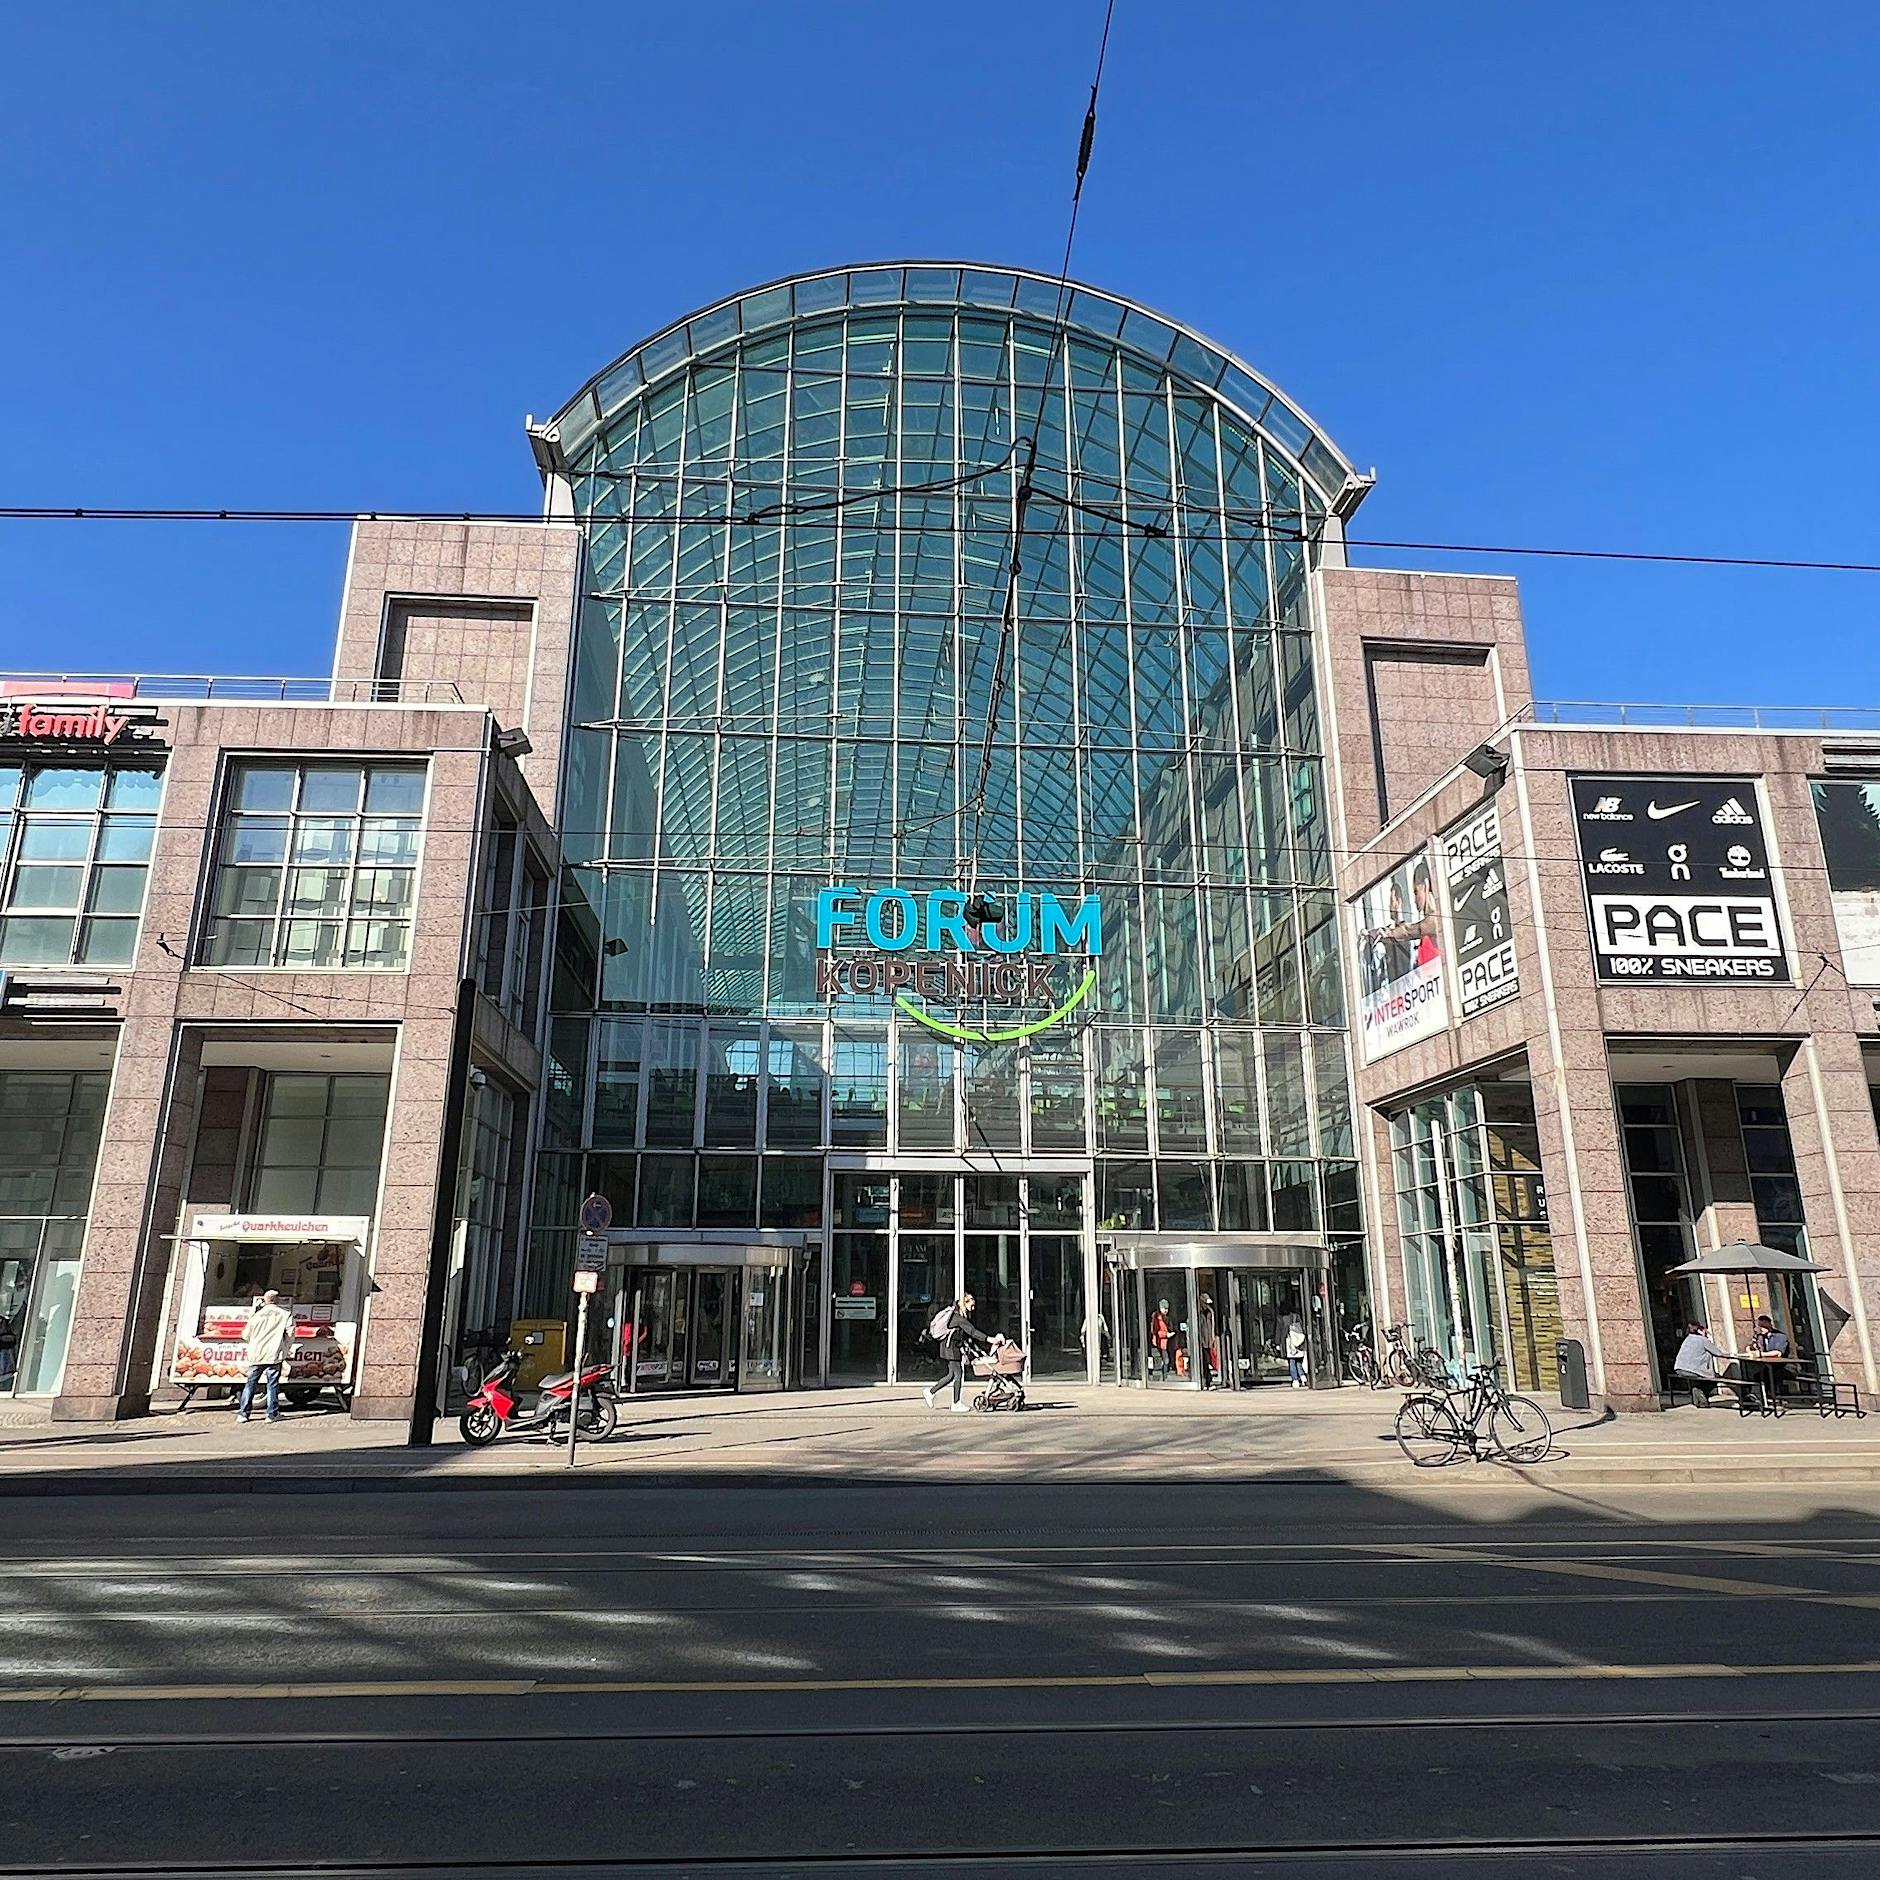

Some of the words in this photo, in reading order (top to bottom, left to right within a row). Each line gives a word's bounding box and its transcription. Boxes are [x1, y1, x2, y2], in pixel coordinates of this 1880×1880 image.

[18, 704, 130, 745] family
[1583, 812, 1600, 820] new
[1600, 812, 1634, 821] balance
[1711, 814, 1754, 825] adidas
[1447, 812, 1498, 871] PACE
[1588, 862, 1645, 874] LACOSTE
[816, 887, 1102, 956] FORUM
[1603, 904, 1768, 947] PACE
[815, 950, 1057, 998] KÖPENICK
[1462, 946, 1514, 996] PACE
[1609, 956, 1654, 975] 100%
[1660, 958, 1775, 976] SNEAKERS
[1374, 976, 1440, 1027] INTERSPORT
[242, 1220, 328, 1232] Quarkkeulchen
